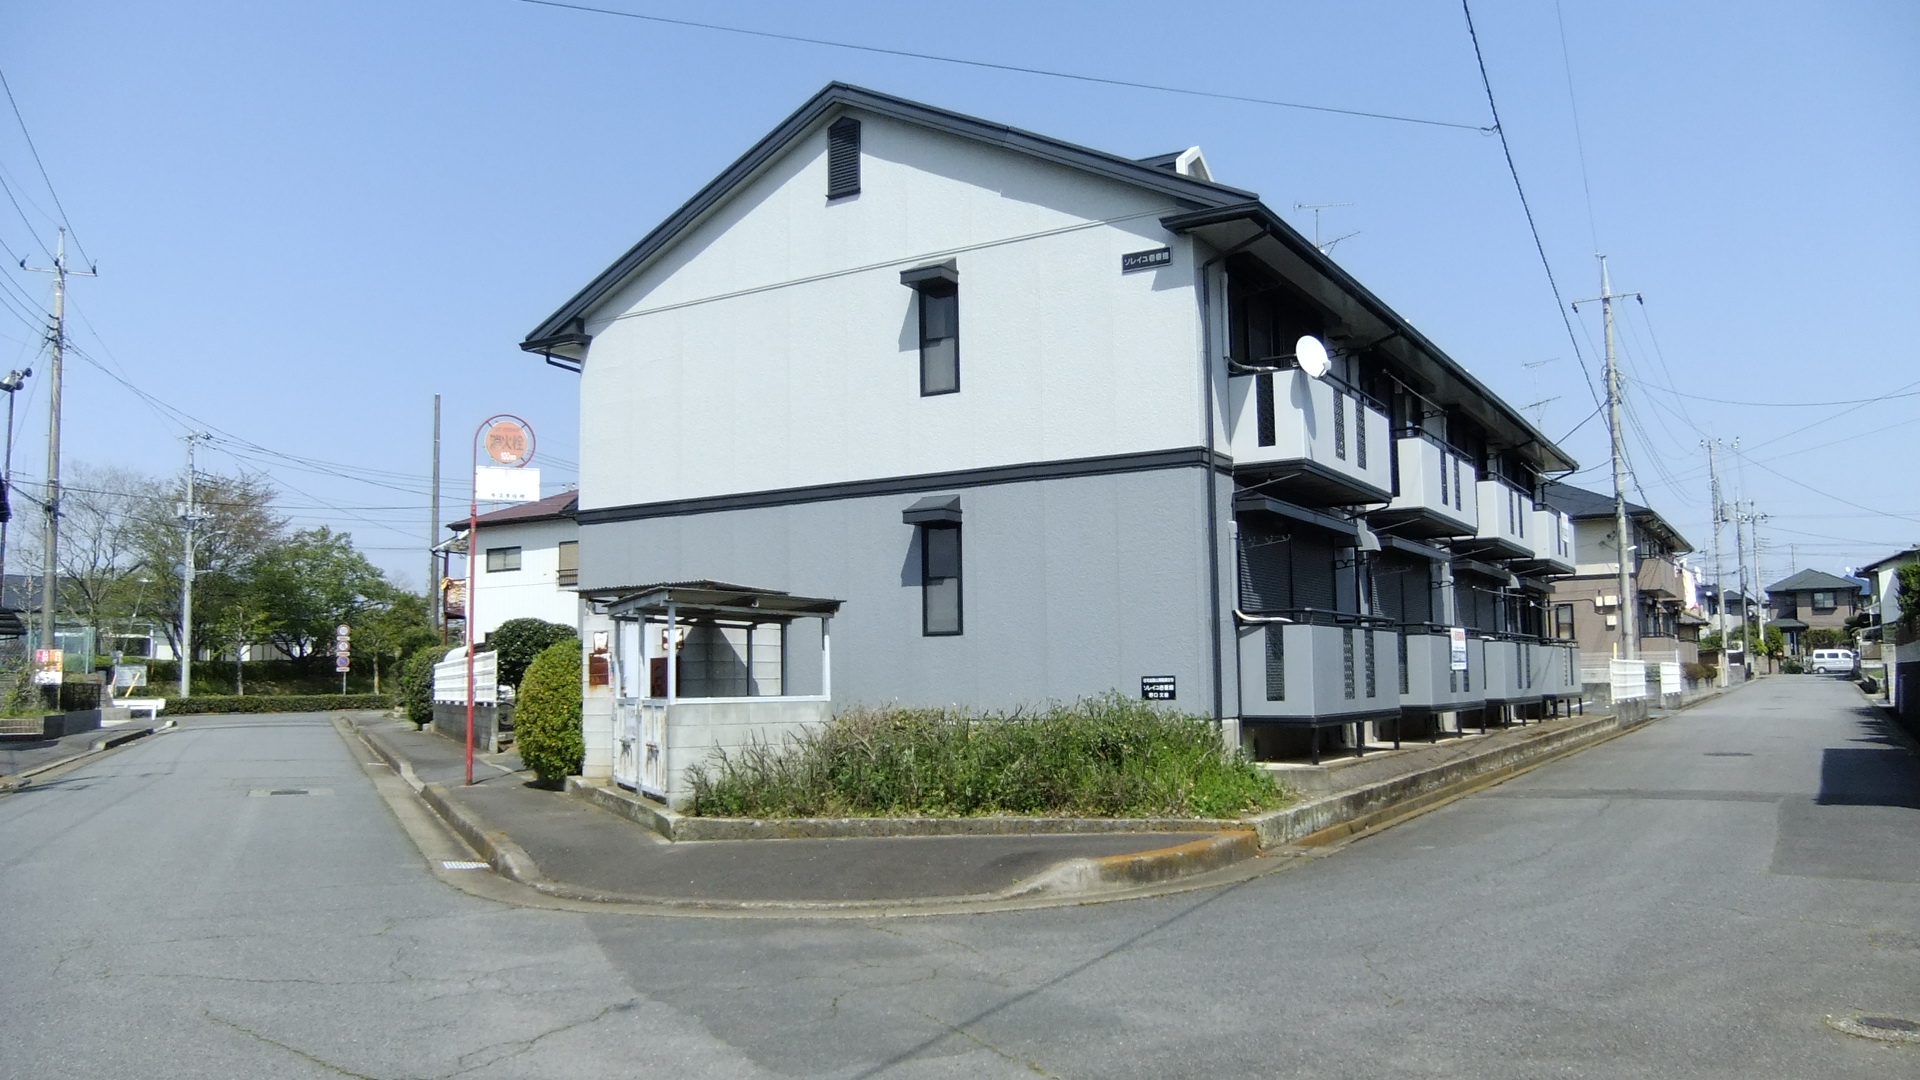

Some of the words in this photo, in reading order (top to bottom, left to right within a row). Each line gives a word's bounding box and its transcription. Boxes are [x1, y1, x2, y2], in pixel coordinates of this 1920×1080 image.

[1124, 252, 1169, 266] ソレイユ
[490, 434, 524, 451] 消火栓
